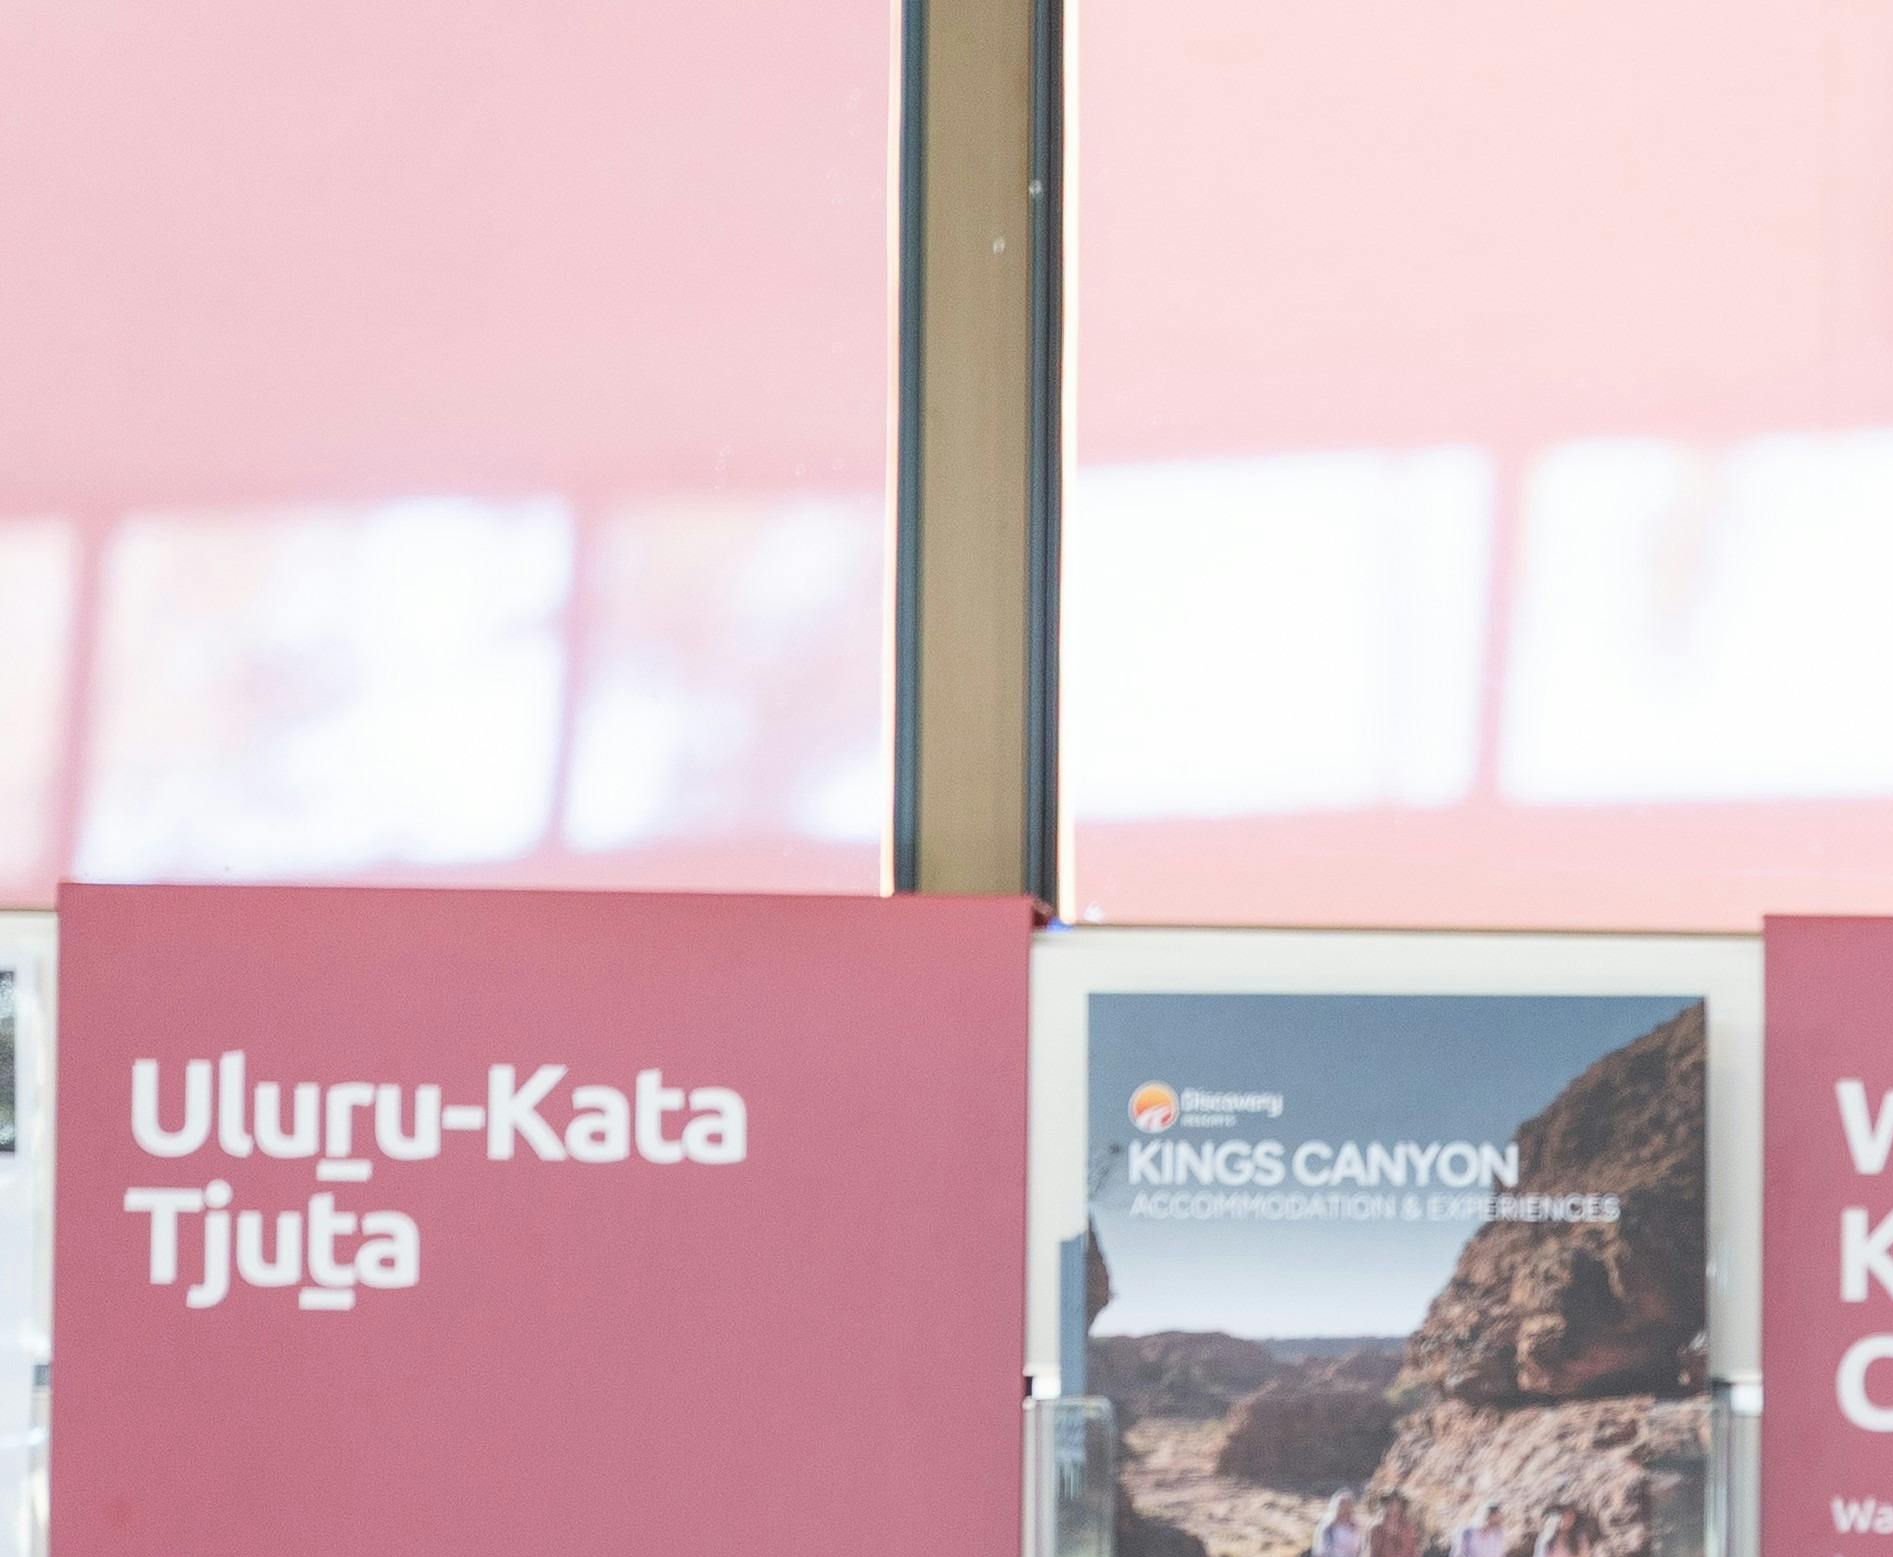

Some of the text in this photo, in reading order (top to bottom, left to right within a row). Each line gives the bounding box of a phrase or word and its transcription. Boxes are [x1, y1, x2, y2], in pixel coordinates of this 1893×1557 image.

[131, 1049, 748, 1181] Uluṟu-Kata
[1129, 1141, 1516, 1188] KINGS CANYON
[1129, 1191, 1621, 1223] ACCOMMODATION & EXPERIENCES
[124, 1180, 420, 1311] Tjuṯa
